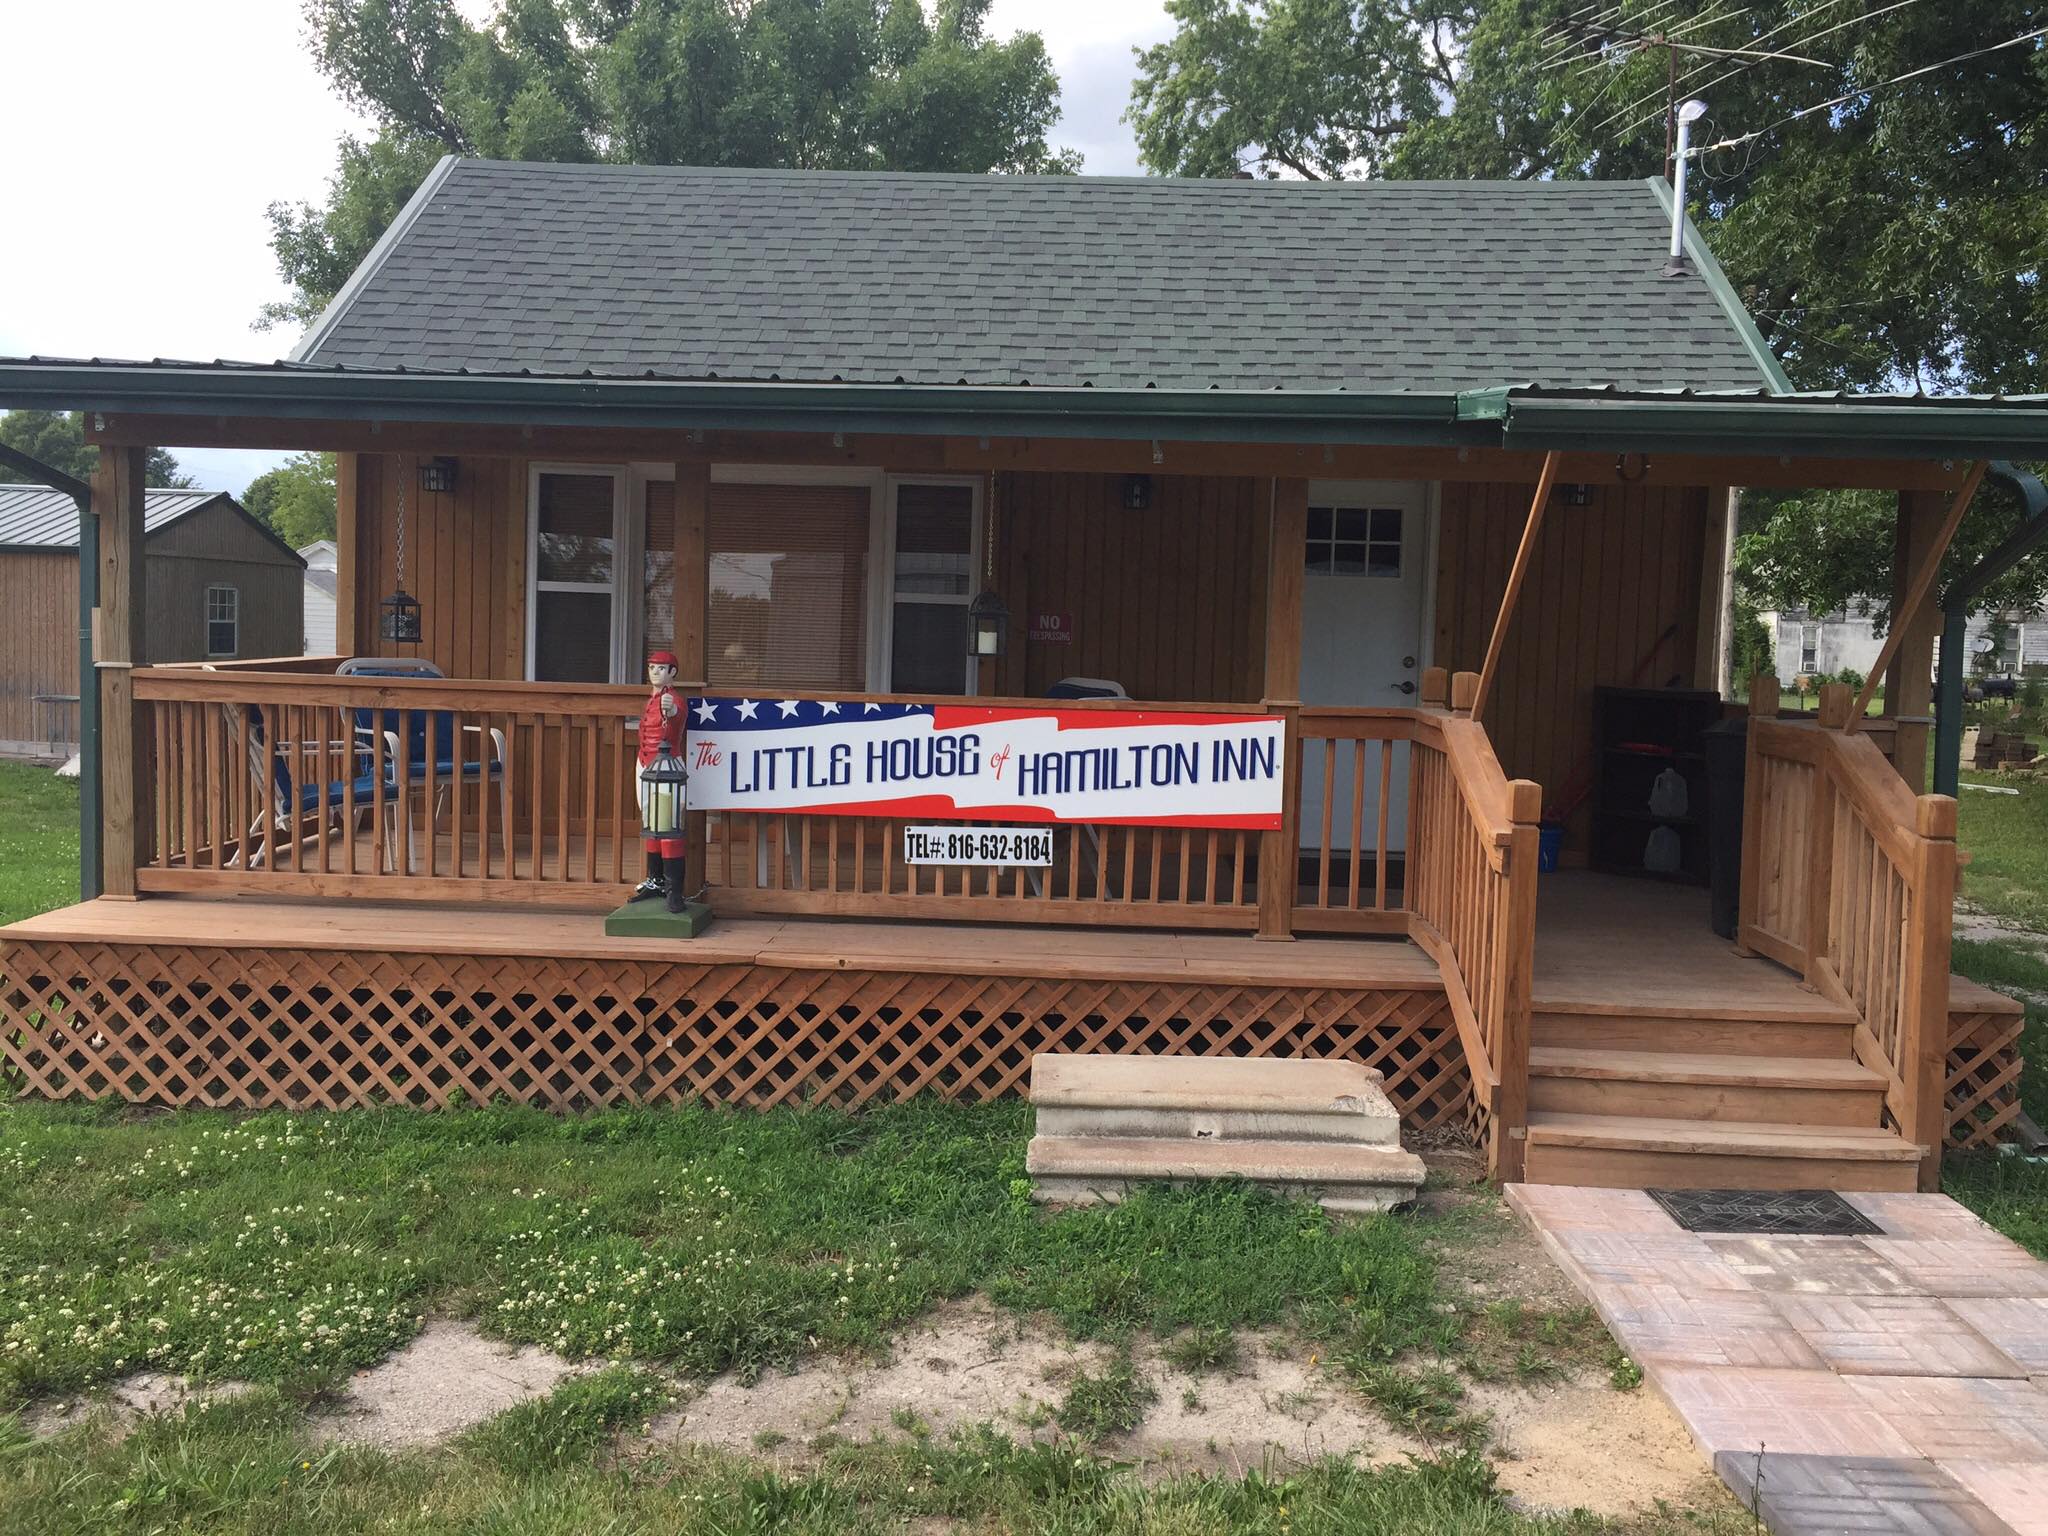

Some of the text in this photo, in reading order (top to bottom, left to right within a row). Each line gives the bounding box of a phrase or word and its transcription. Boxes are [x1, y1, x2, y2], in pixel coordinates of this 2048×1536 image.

[1039, 615, 1060, 629] NO
[695, 734, 1275, 796] The LITTLE HOUSE of HAMILTON INN
[907, 833, 1050, 861] TEL#: 816-632-8184
